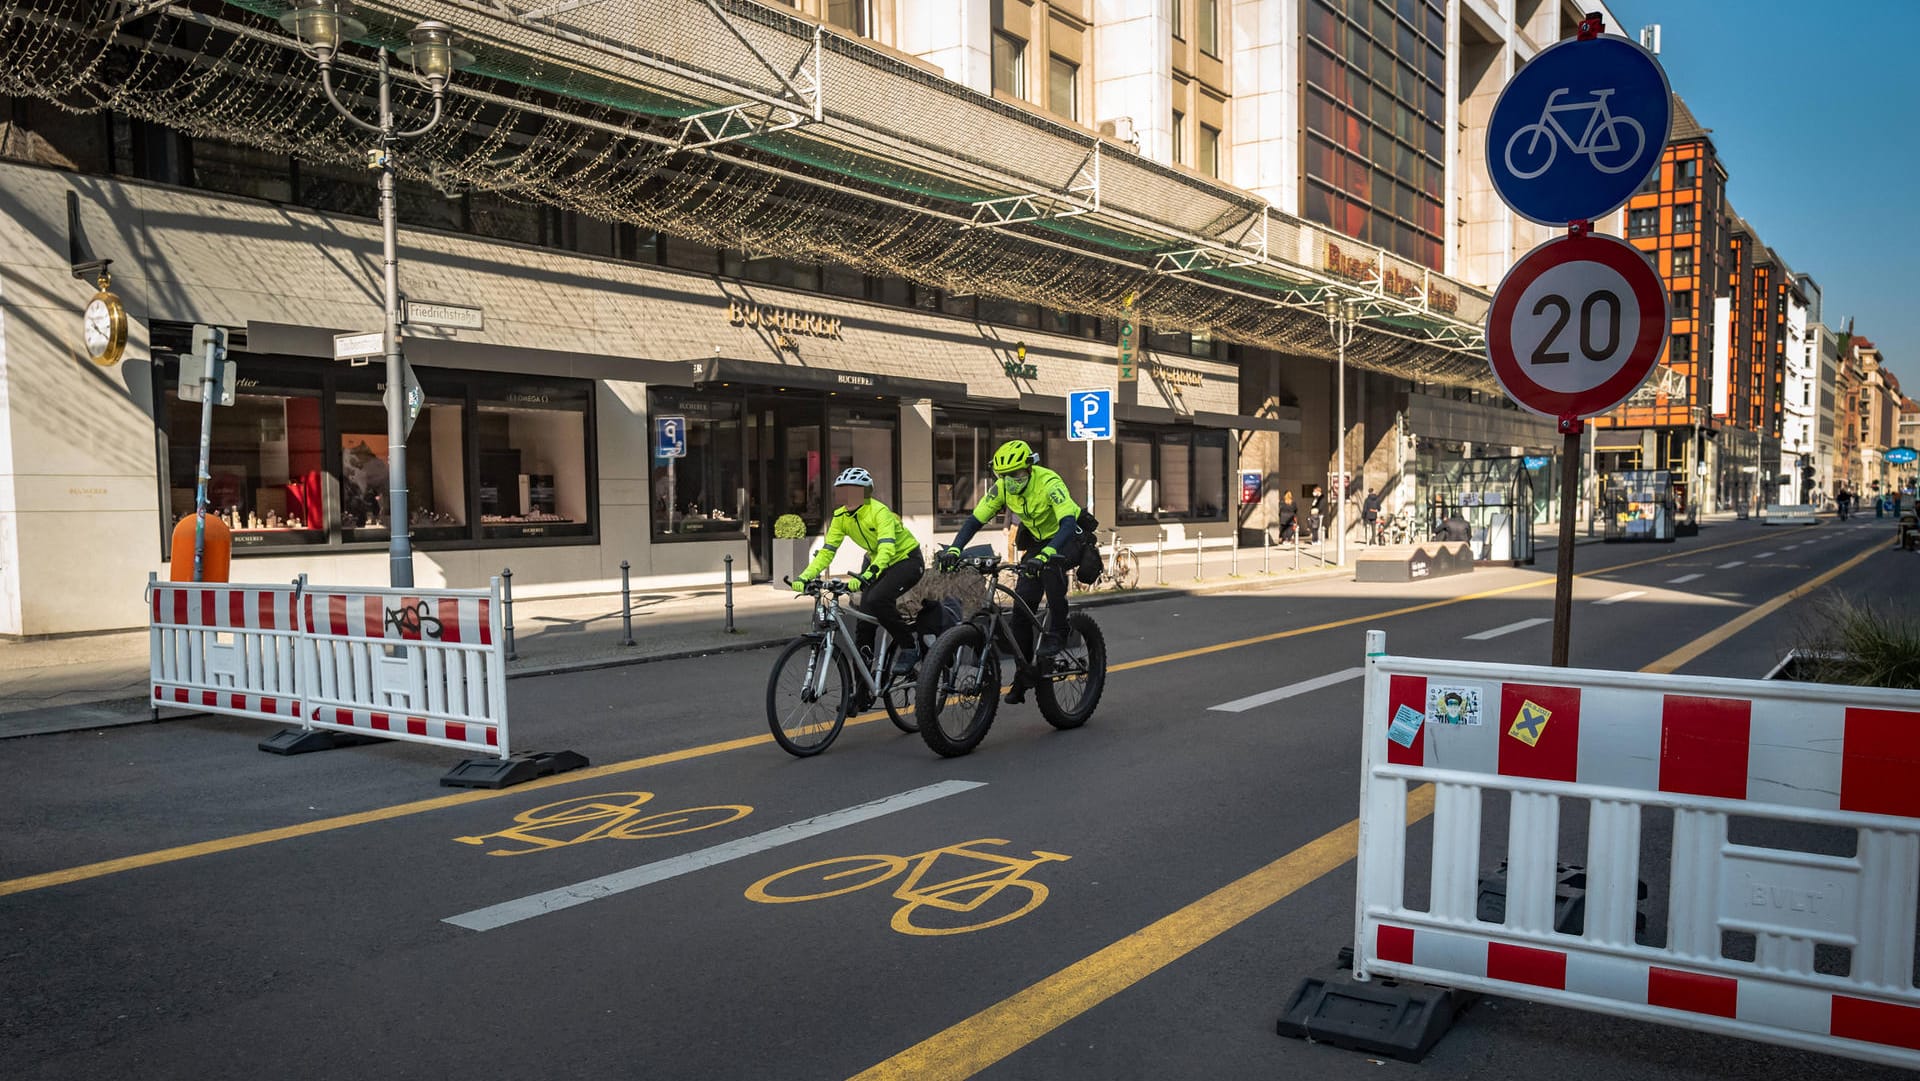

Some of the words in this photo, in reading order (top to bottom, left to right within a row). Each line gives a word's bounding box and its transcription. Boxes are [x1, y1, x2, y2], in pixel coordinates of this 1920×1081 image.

[410, 304, 476, 325] Friedrichstraße
[728, 301, 842, 336] BUCHERER
[1530, 289, 1620, 364] 20
[1083, 400, 1099, 424] P
